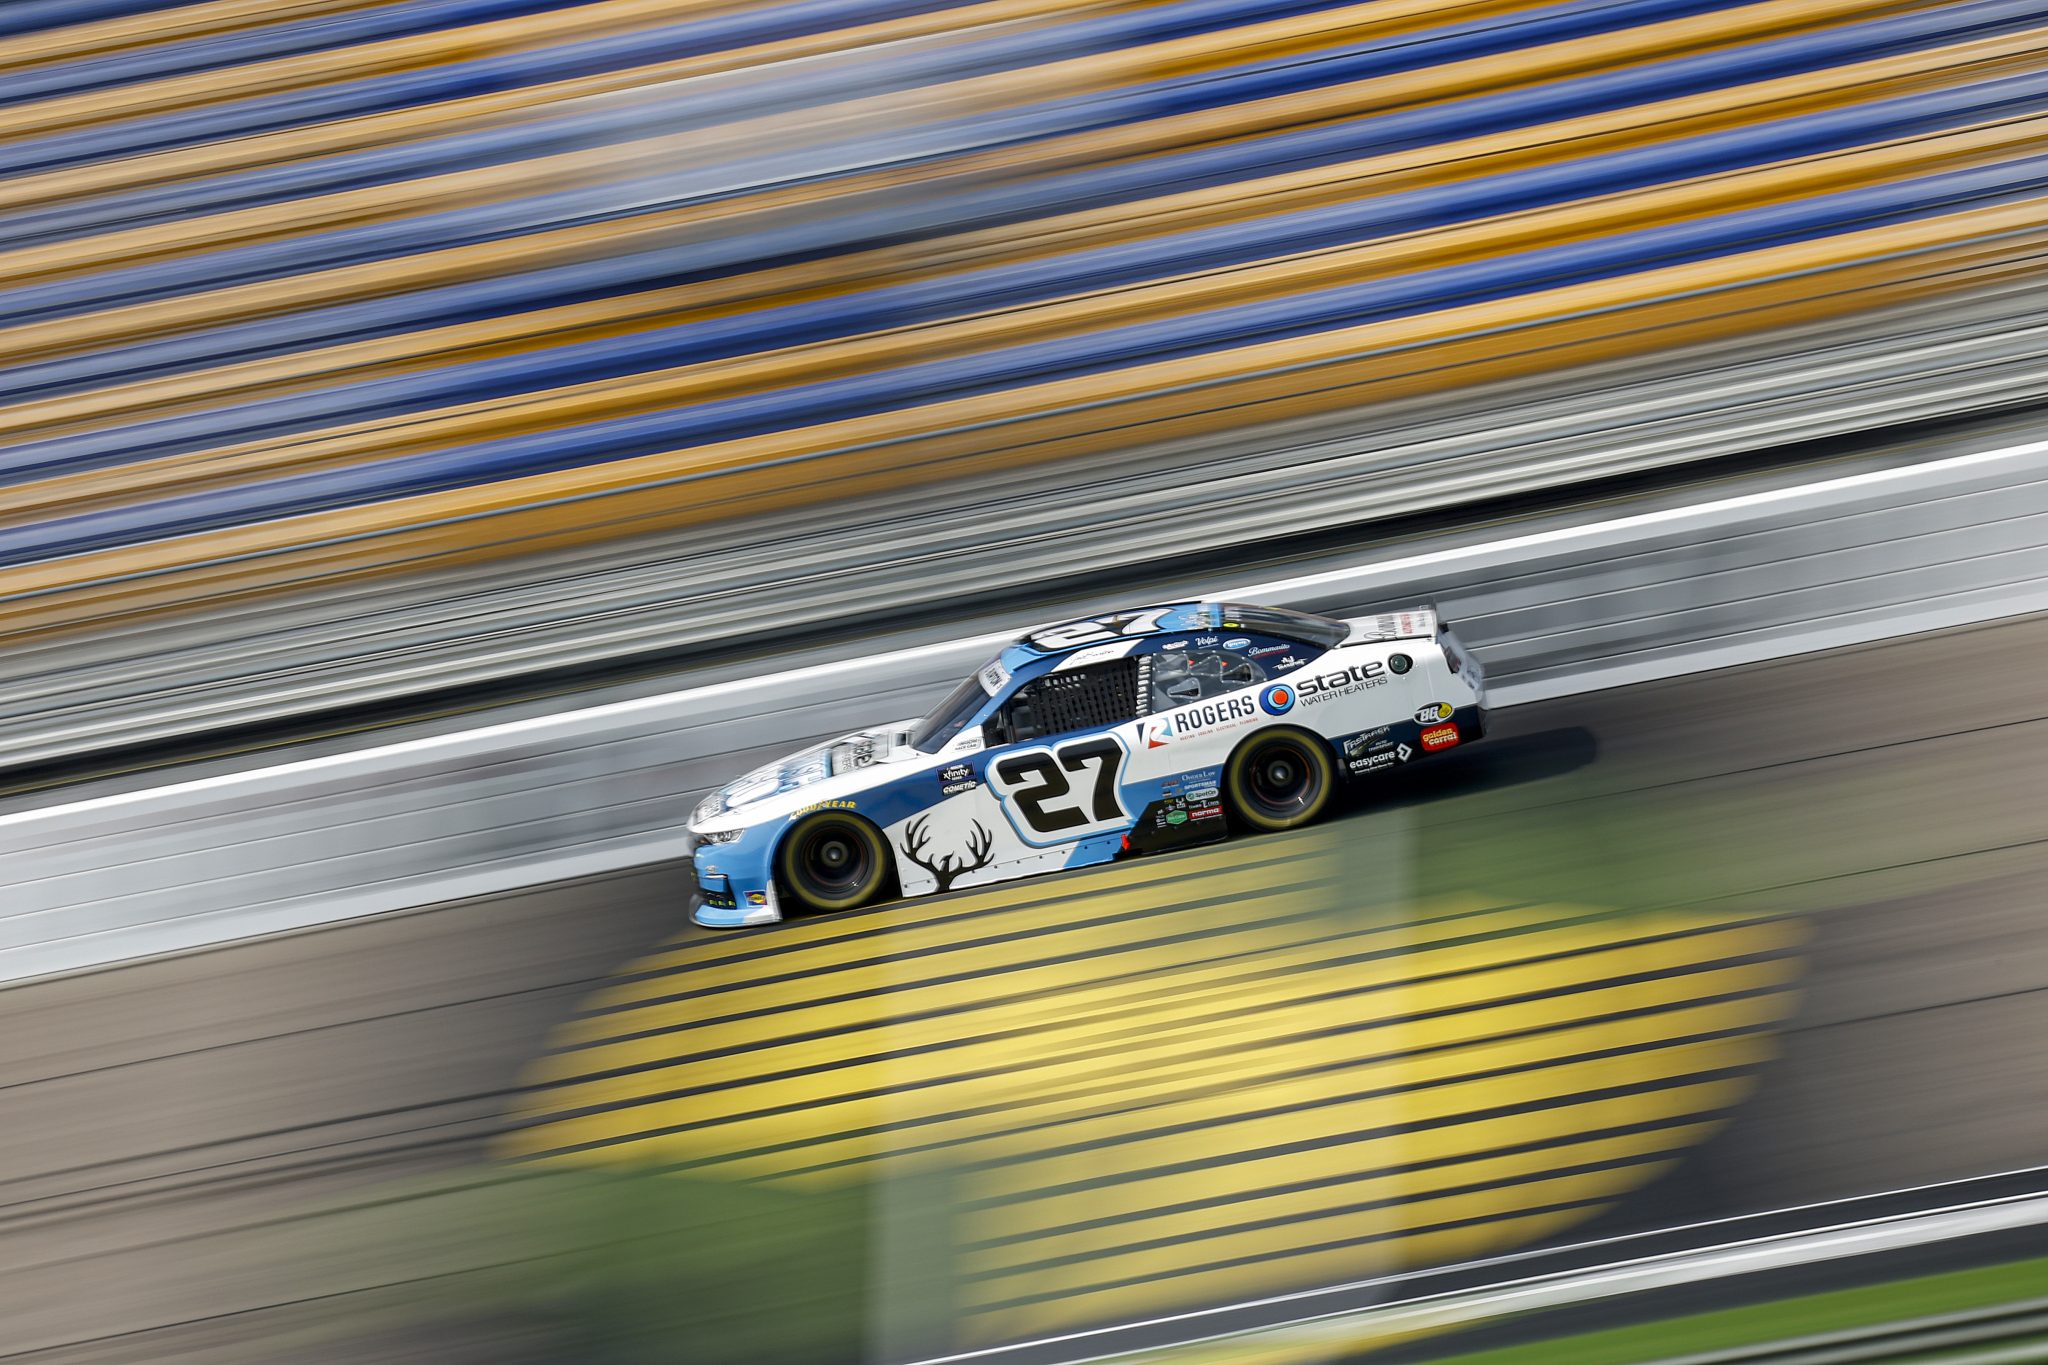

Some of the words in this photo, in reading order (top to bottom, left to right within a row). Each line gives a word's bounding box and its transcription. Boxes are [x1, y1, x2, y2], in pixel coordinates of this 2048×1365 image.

[1296, 661, 1385, 698] state
[1300, 689, 1338, 707] WATER
[1339, 677, 1388, 697] HEATERS
[1175, 695, 1255, 733] ROGERS
[1423, 728, 1453, 742] golden
[1429, 731, 1457, 745] corral
[1350, 751, 1395, 769] easycare
[943, 767, 969, 780] xfinity
[996, 737, 1125, 833] 27
[1192, 807, 1219, 818] norma
